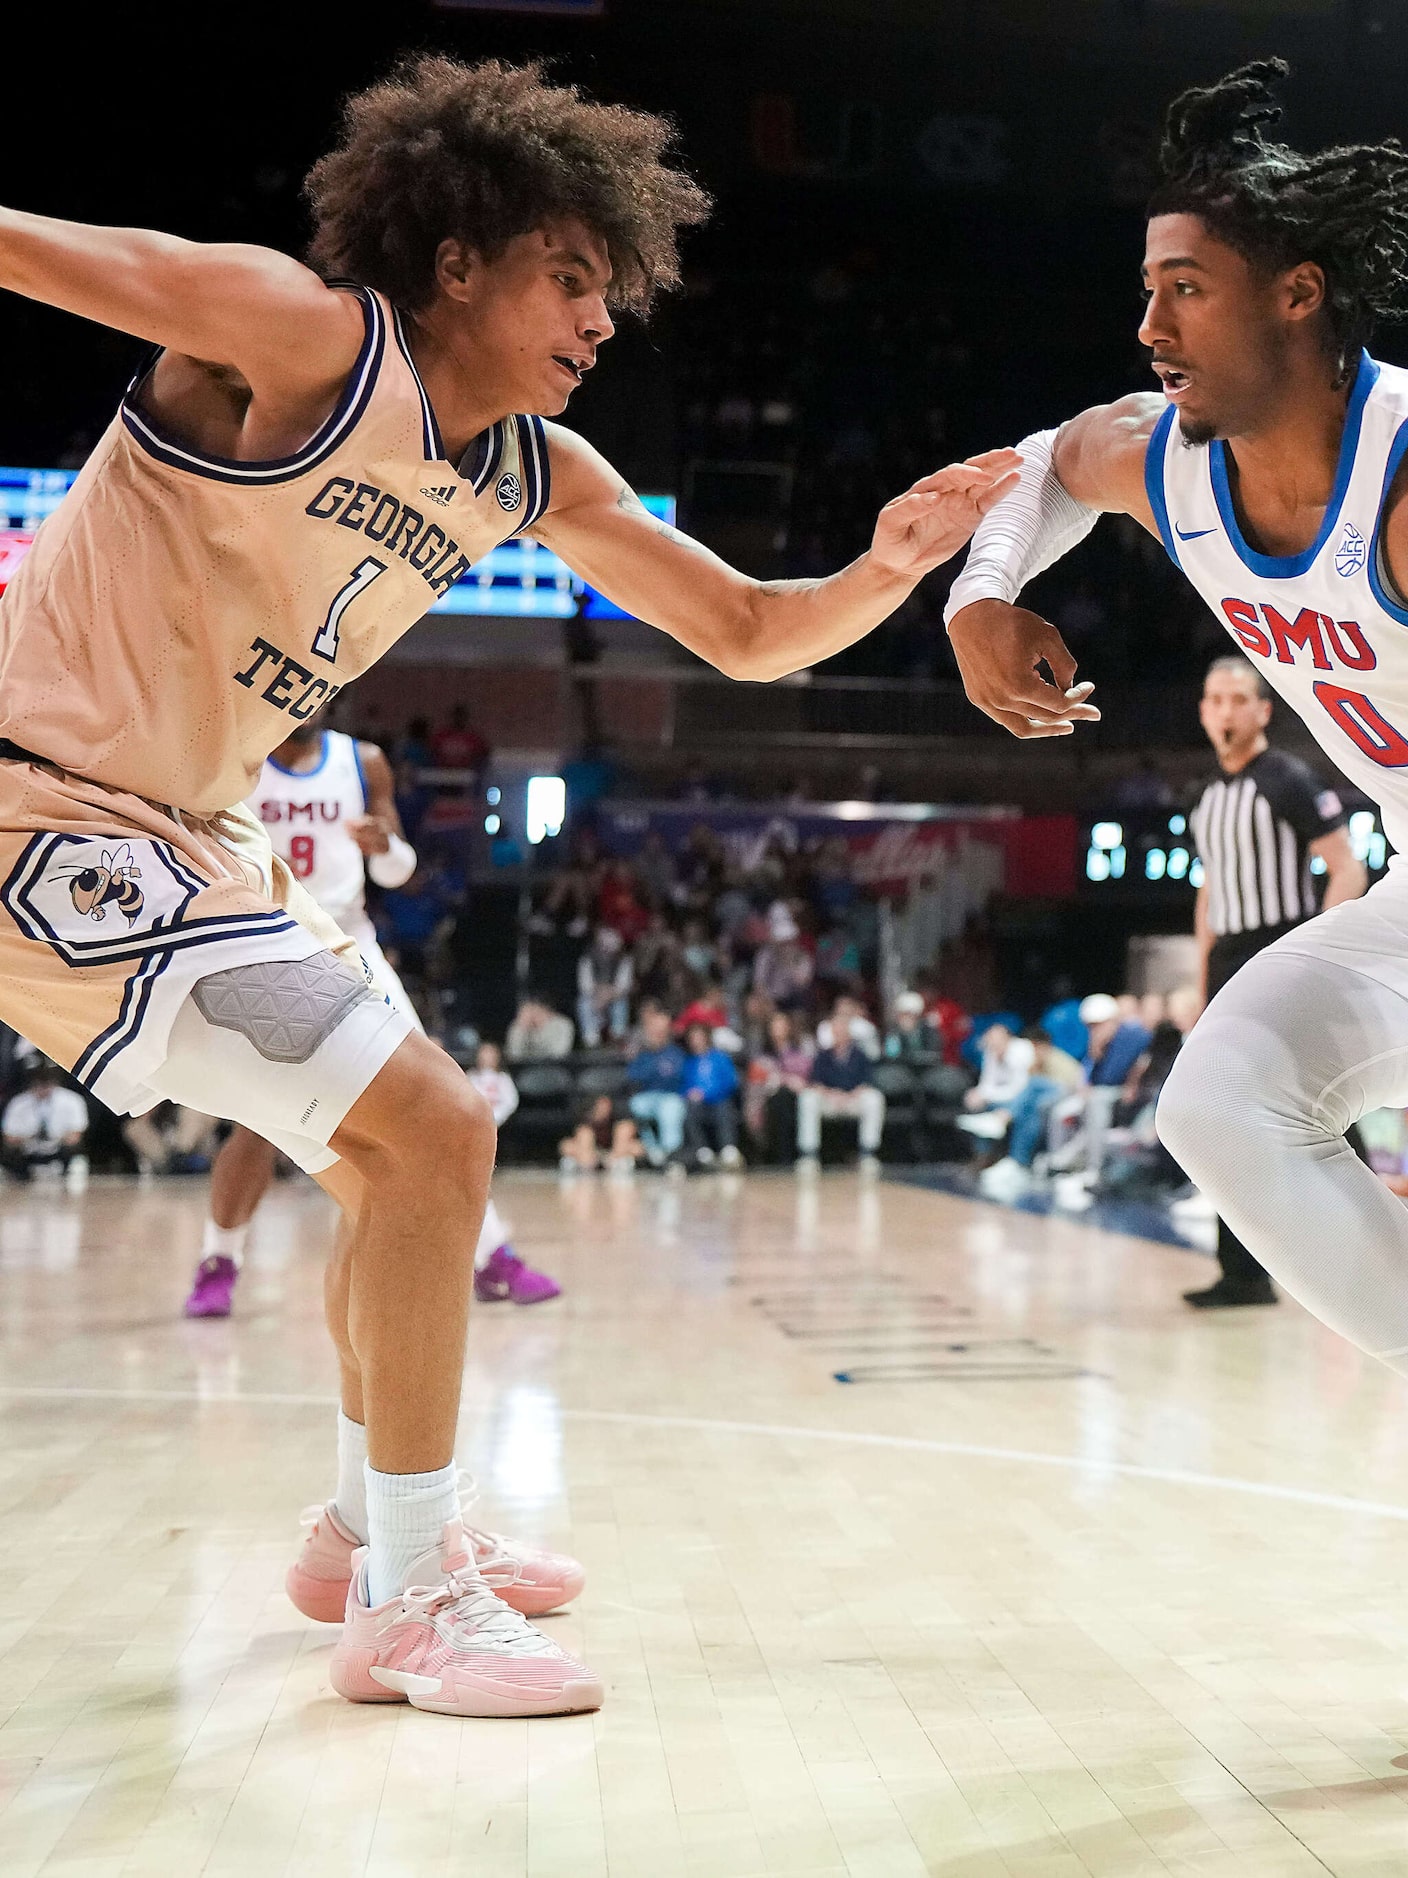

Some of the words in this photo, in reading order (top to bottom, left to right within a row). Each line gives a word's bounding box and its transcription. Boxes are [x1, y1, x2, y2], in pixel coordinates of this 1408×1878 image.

[501, 484, 521, 501] ACC
[305, 475, 472, 600] GEORGIA
[1339, 540, 1364, 554] ACC
[310, 555, 389, 664] 1
[1221, 597, 1377, 671] SMU
[233, 636, 340, 720] TEC
[260, 800, 340, 823] SMU
